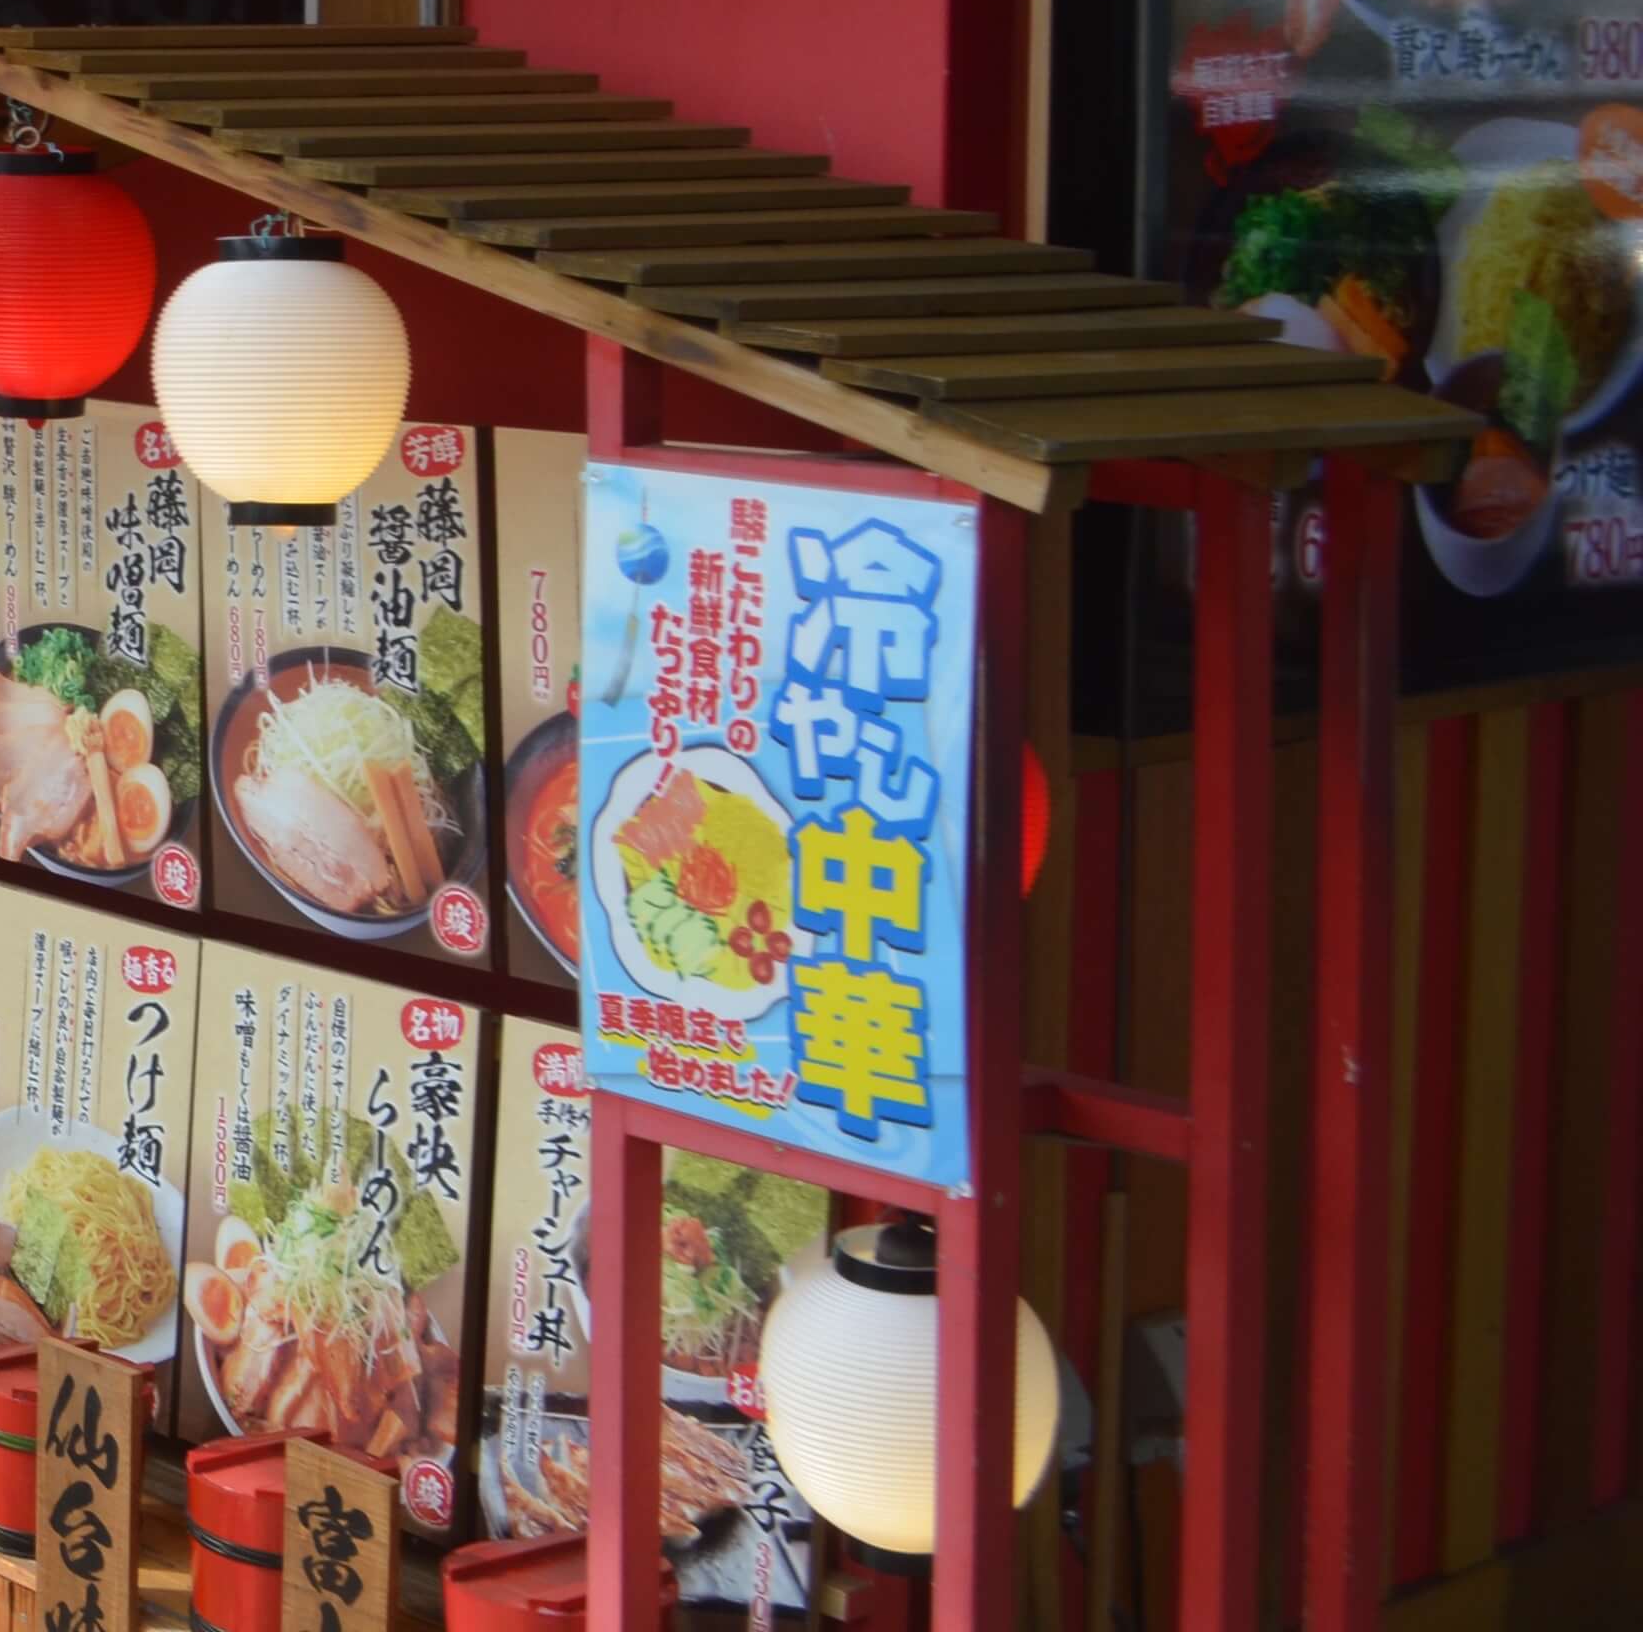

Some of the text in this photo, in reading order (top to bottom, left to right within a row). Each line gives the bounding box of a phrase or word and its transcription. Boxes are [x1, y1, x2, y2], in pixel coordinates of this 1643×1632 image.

[145, 472, 191, 594] 藤岡
[405, 432, 463, 472] 芳醇
[104, 492, 147, 665] 味噌麺
[370, 503, 418, 693] 醤油麺
[417, 477, 466, 611] 藤岡
[529, 570, 551, 691] 780円
[724, 496, 769, 759] 駿こだわりの
[647, 602, 687, 800] たっぷり!
[686, 548, 727, 727] 新鮮食材
[771, 518, 943, 1142] 冷やし中華
[124, 951, 177, 989] 麺香る
[407, 1008, 463, 1042] 名物
[595, 988, 747, 1055] 夏季限定で
[118, 1001, 169, 1187] つけ麺
[231, 988, 258, 1182] 味噌もしくは醤油
[408, 1052, 464, 1201] 豪快
[646, 1042, 798, 1112] 始めました!
[359, 1067, 401, 1277] らーめん
[527, 1132, 583, 1368] チャーシュー丼
